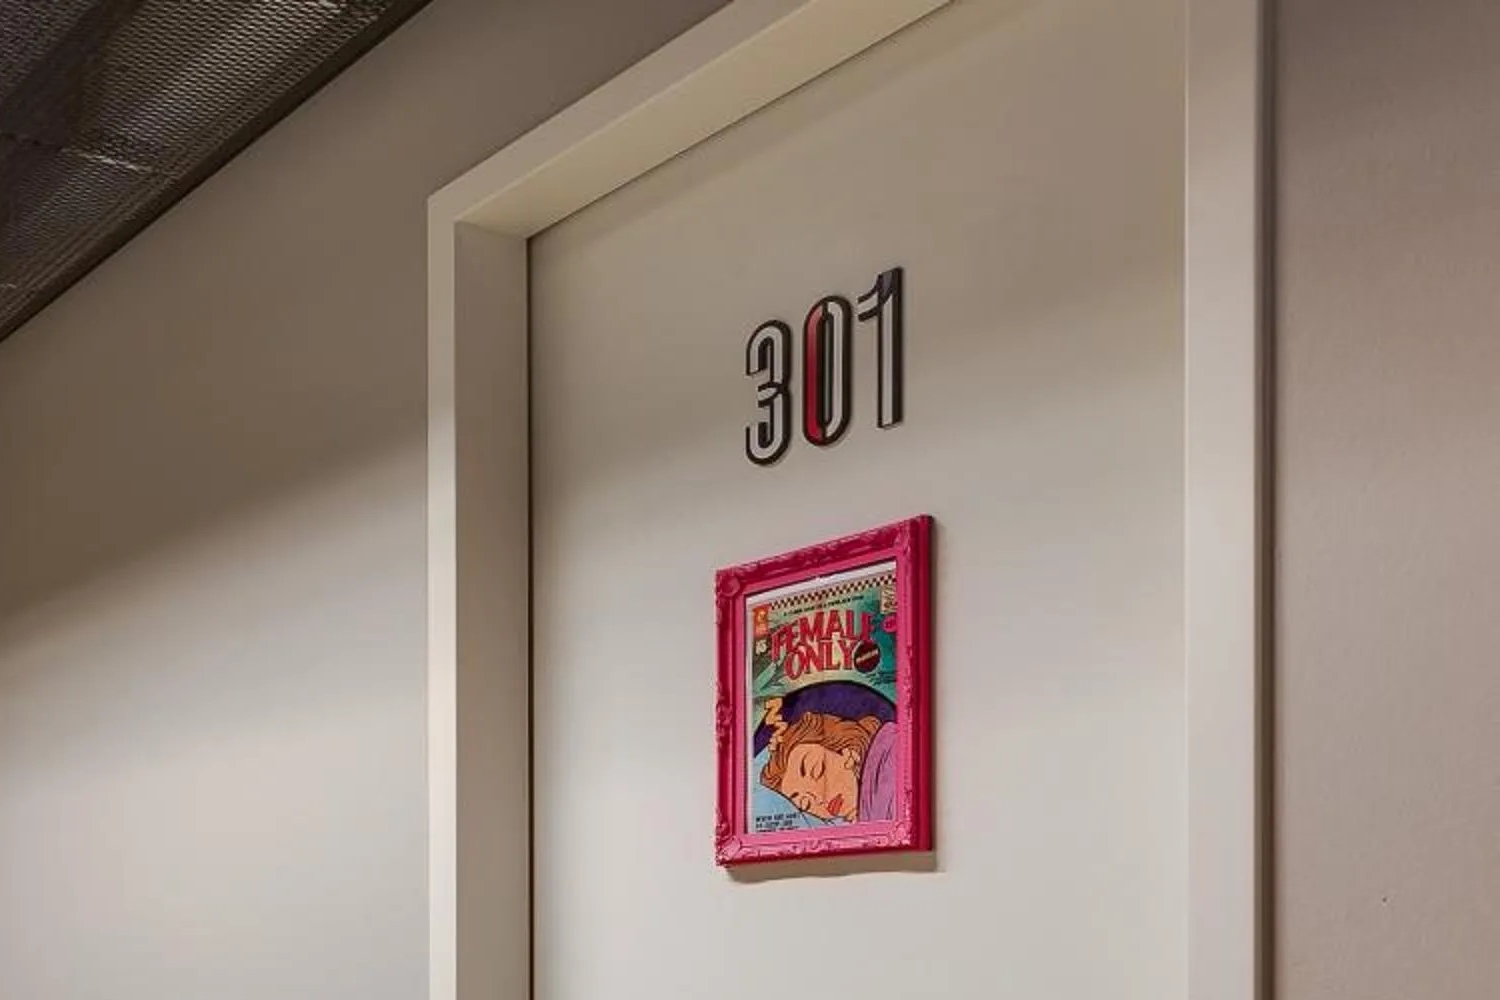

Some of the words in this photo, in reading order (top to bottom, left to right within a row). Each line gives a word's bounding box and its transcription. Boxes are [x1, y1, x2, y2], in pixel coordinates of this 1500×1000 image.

[746, 267, 904, 466] 301
[770, 608, 875, 663] FEMALE
[783, 639, 857, 681] ONLY
